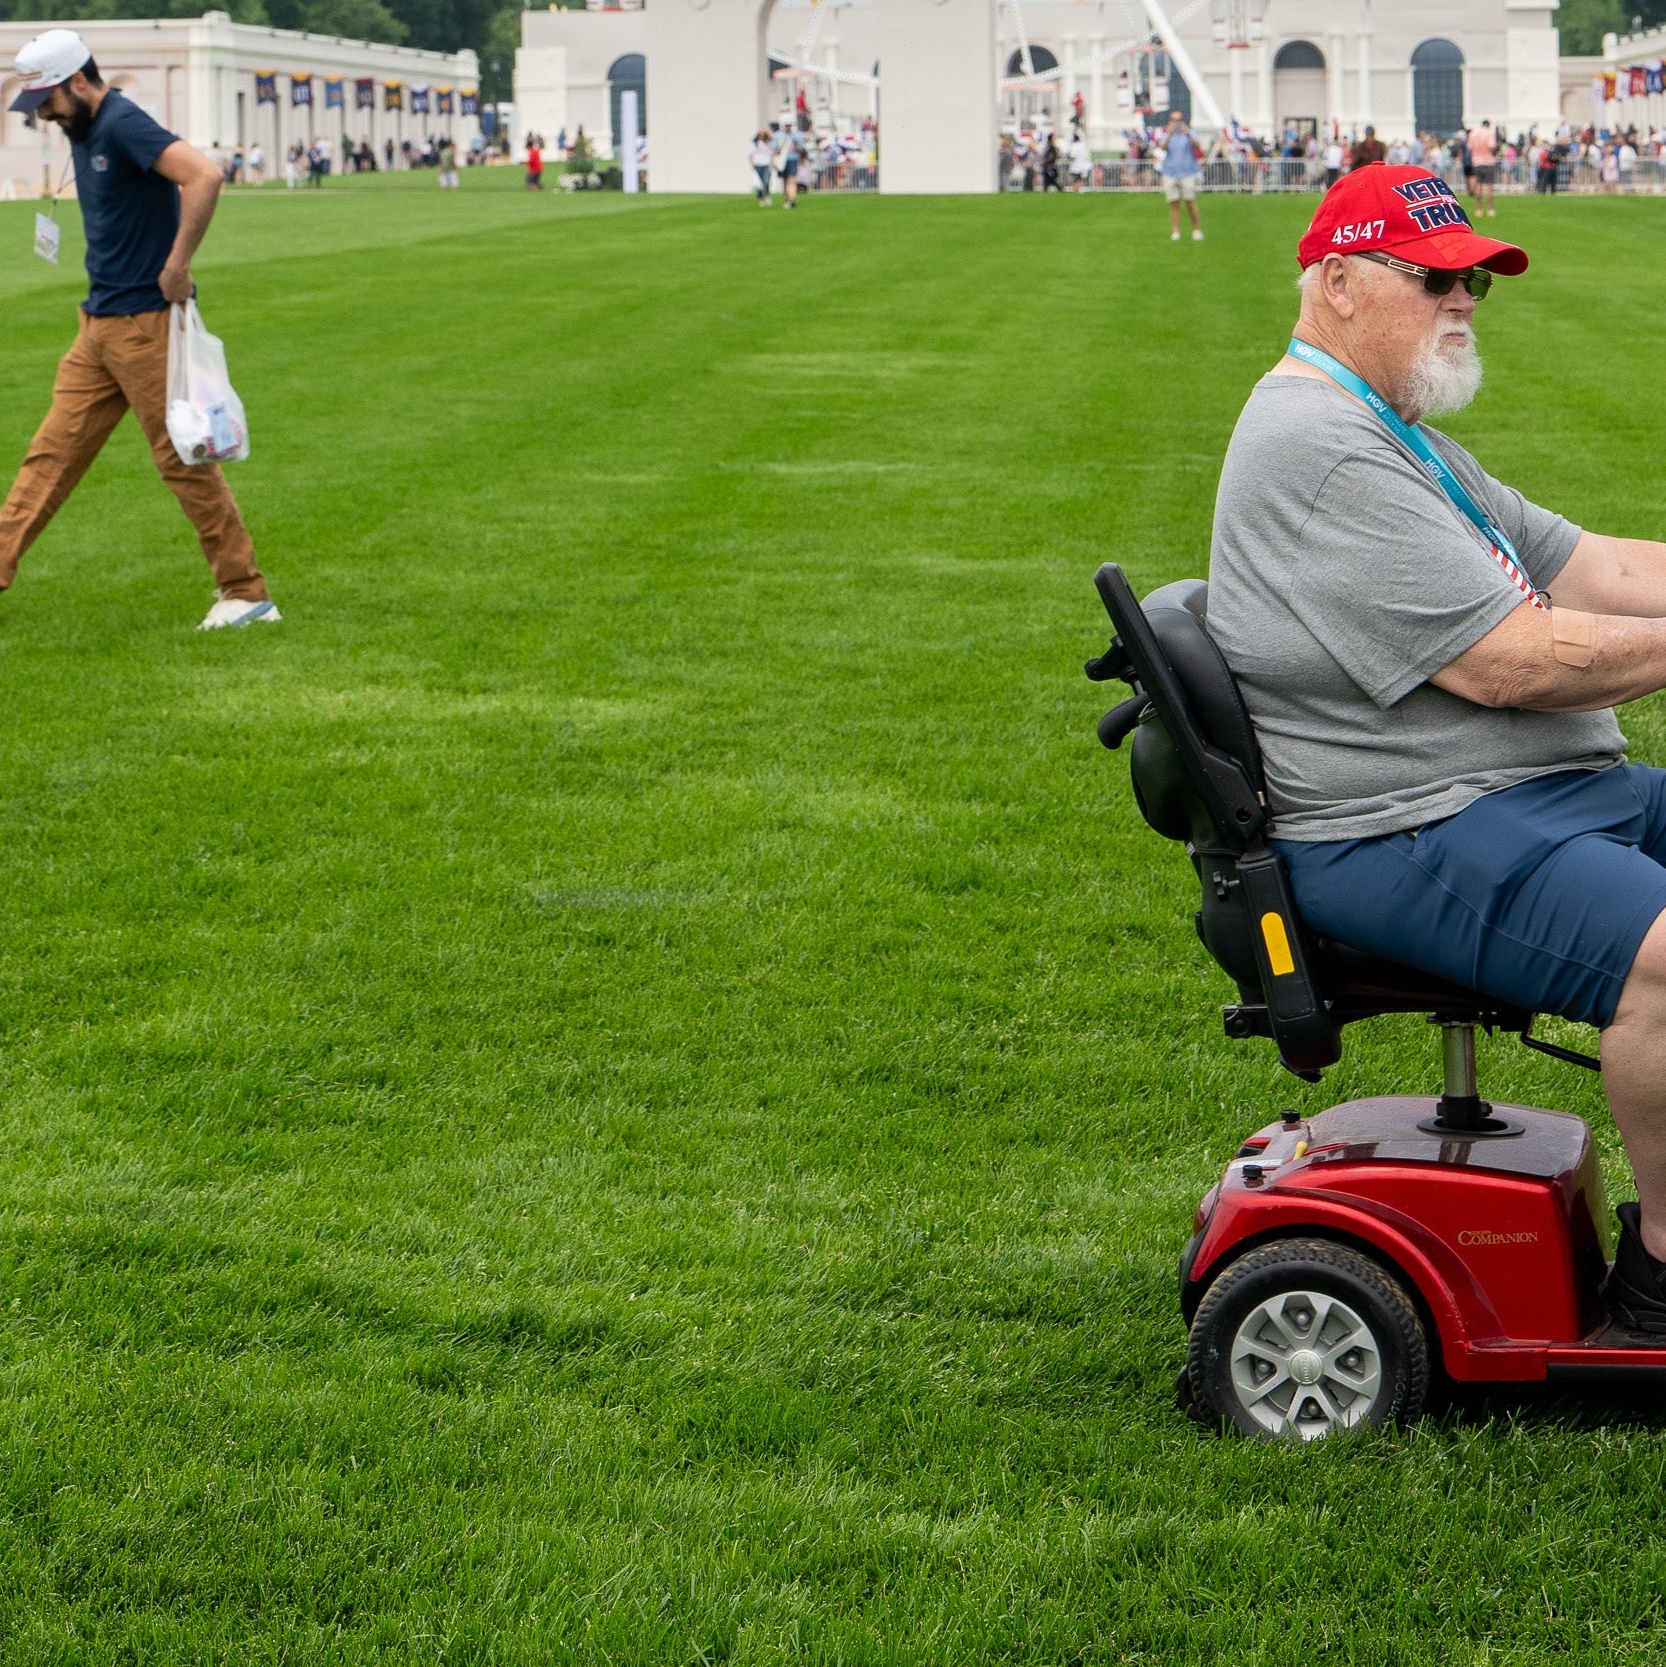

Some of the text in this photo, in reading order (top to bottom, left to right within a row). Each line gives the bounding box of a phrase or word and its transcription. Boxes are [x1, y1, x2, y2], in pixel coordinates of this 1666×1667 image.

[1331, 219, 1386, 245] 45/47
[1294, 344, 1316, 358] HGV
[1366, 392, 1386, 413] HGV
[1425, 458, 1446, 479] HGV
[1482, 526, 1501, 546] HGV
[1457, 1230, 1538, 1246] COMPANION
